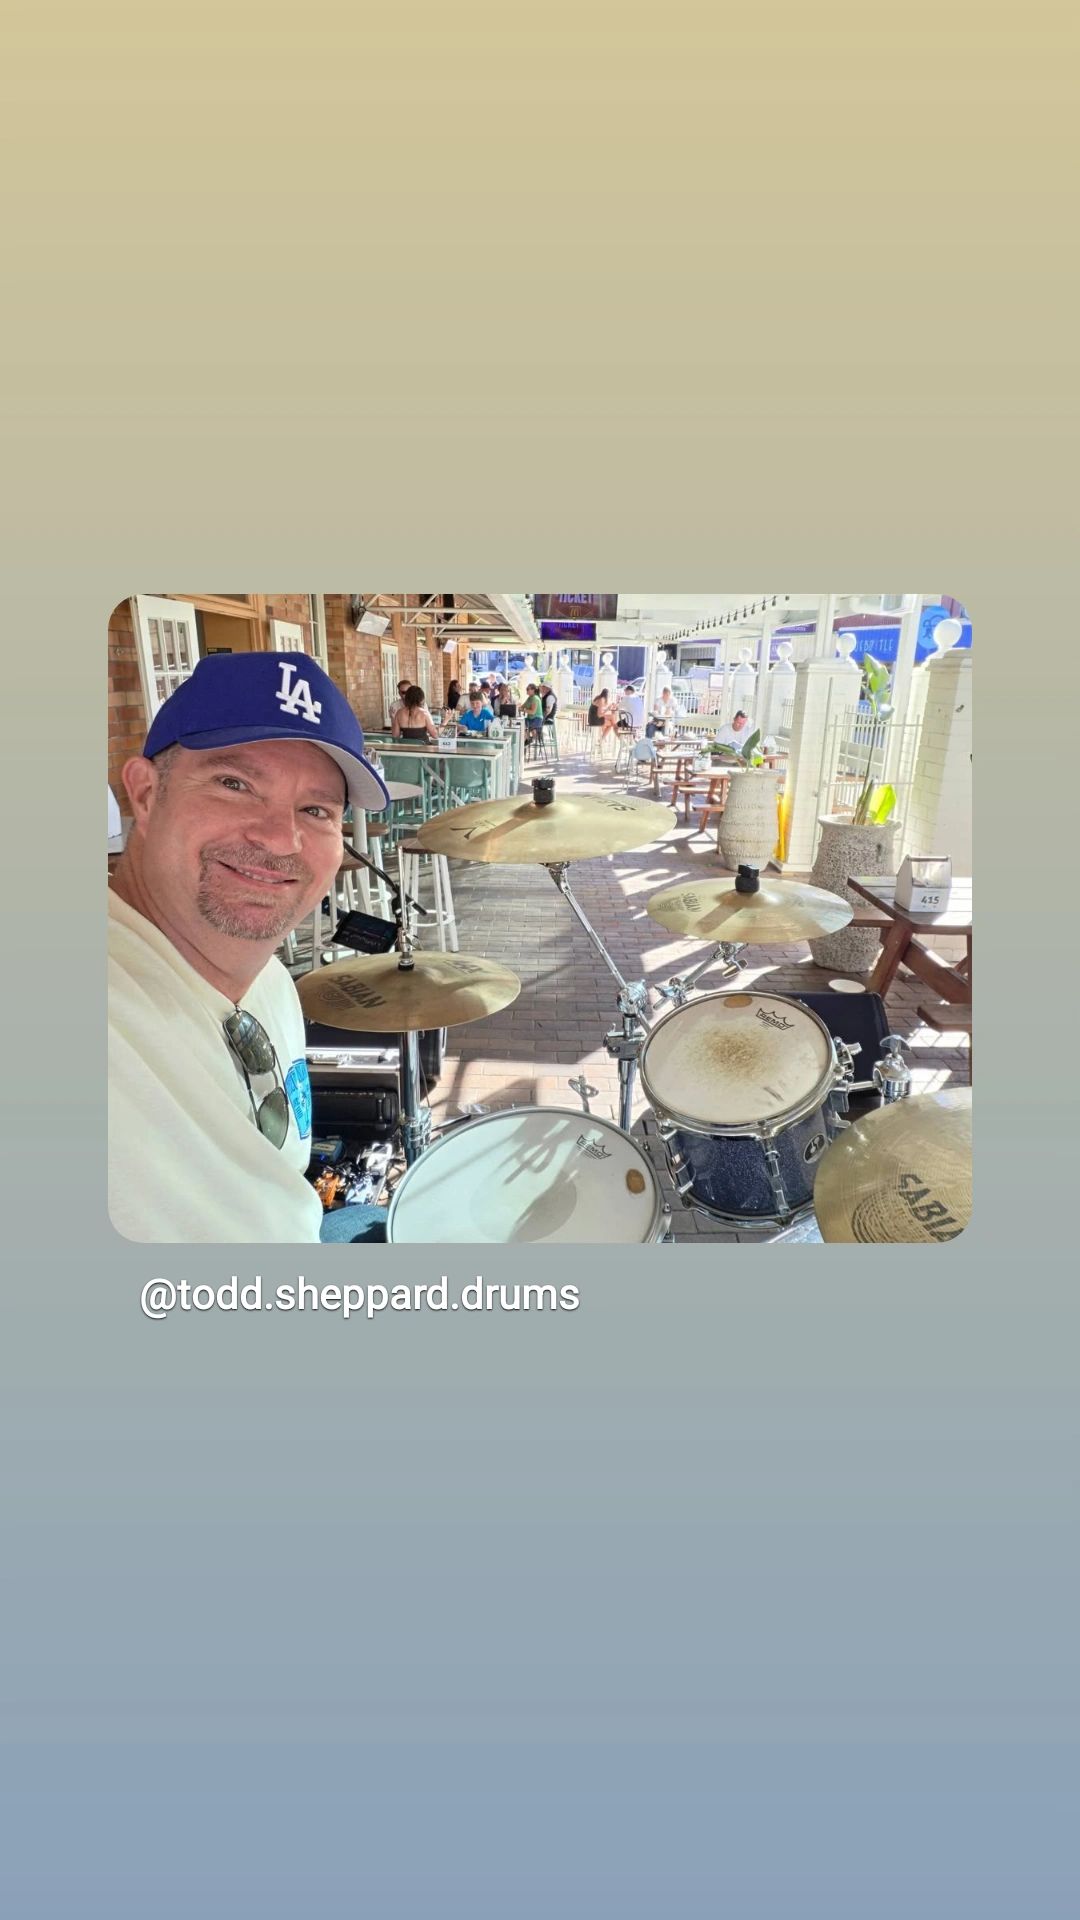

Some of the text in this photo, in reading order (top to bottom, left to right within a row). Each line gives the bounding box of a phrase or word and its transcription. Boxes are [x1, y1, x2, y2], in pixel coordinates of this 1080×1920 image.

[275, 661, 322, 725] LA
[920, 895, 940, 905] 415
[329, 974, 387, 1008] SABIAN
[759, 1011, 787, 1030] REMO
